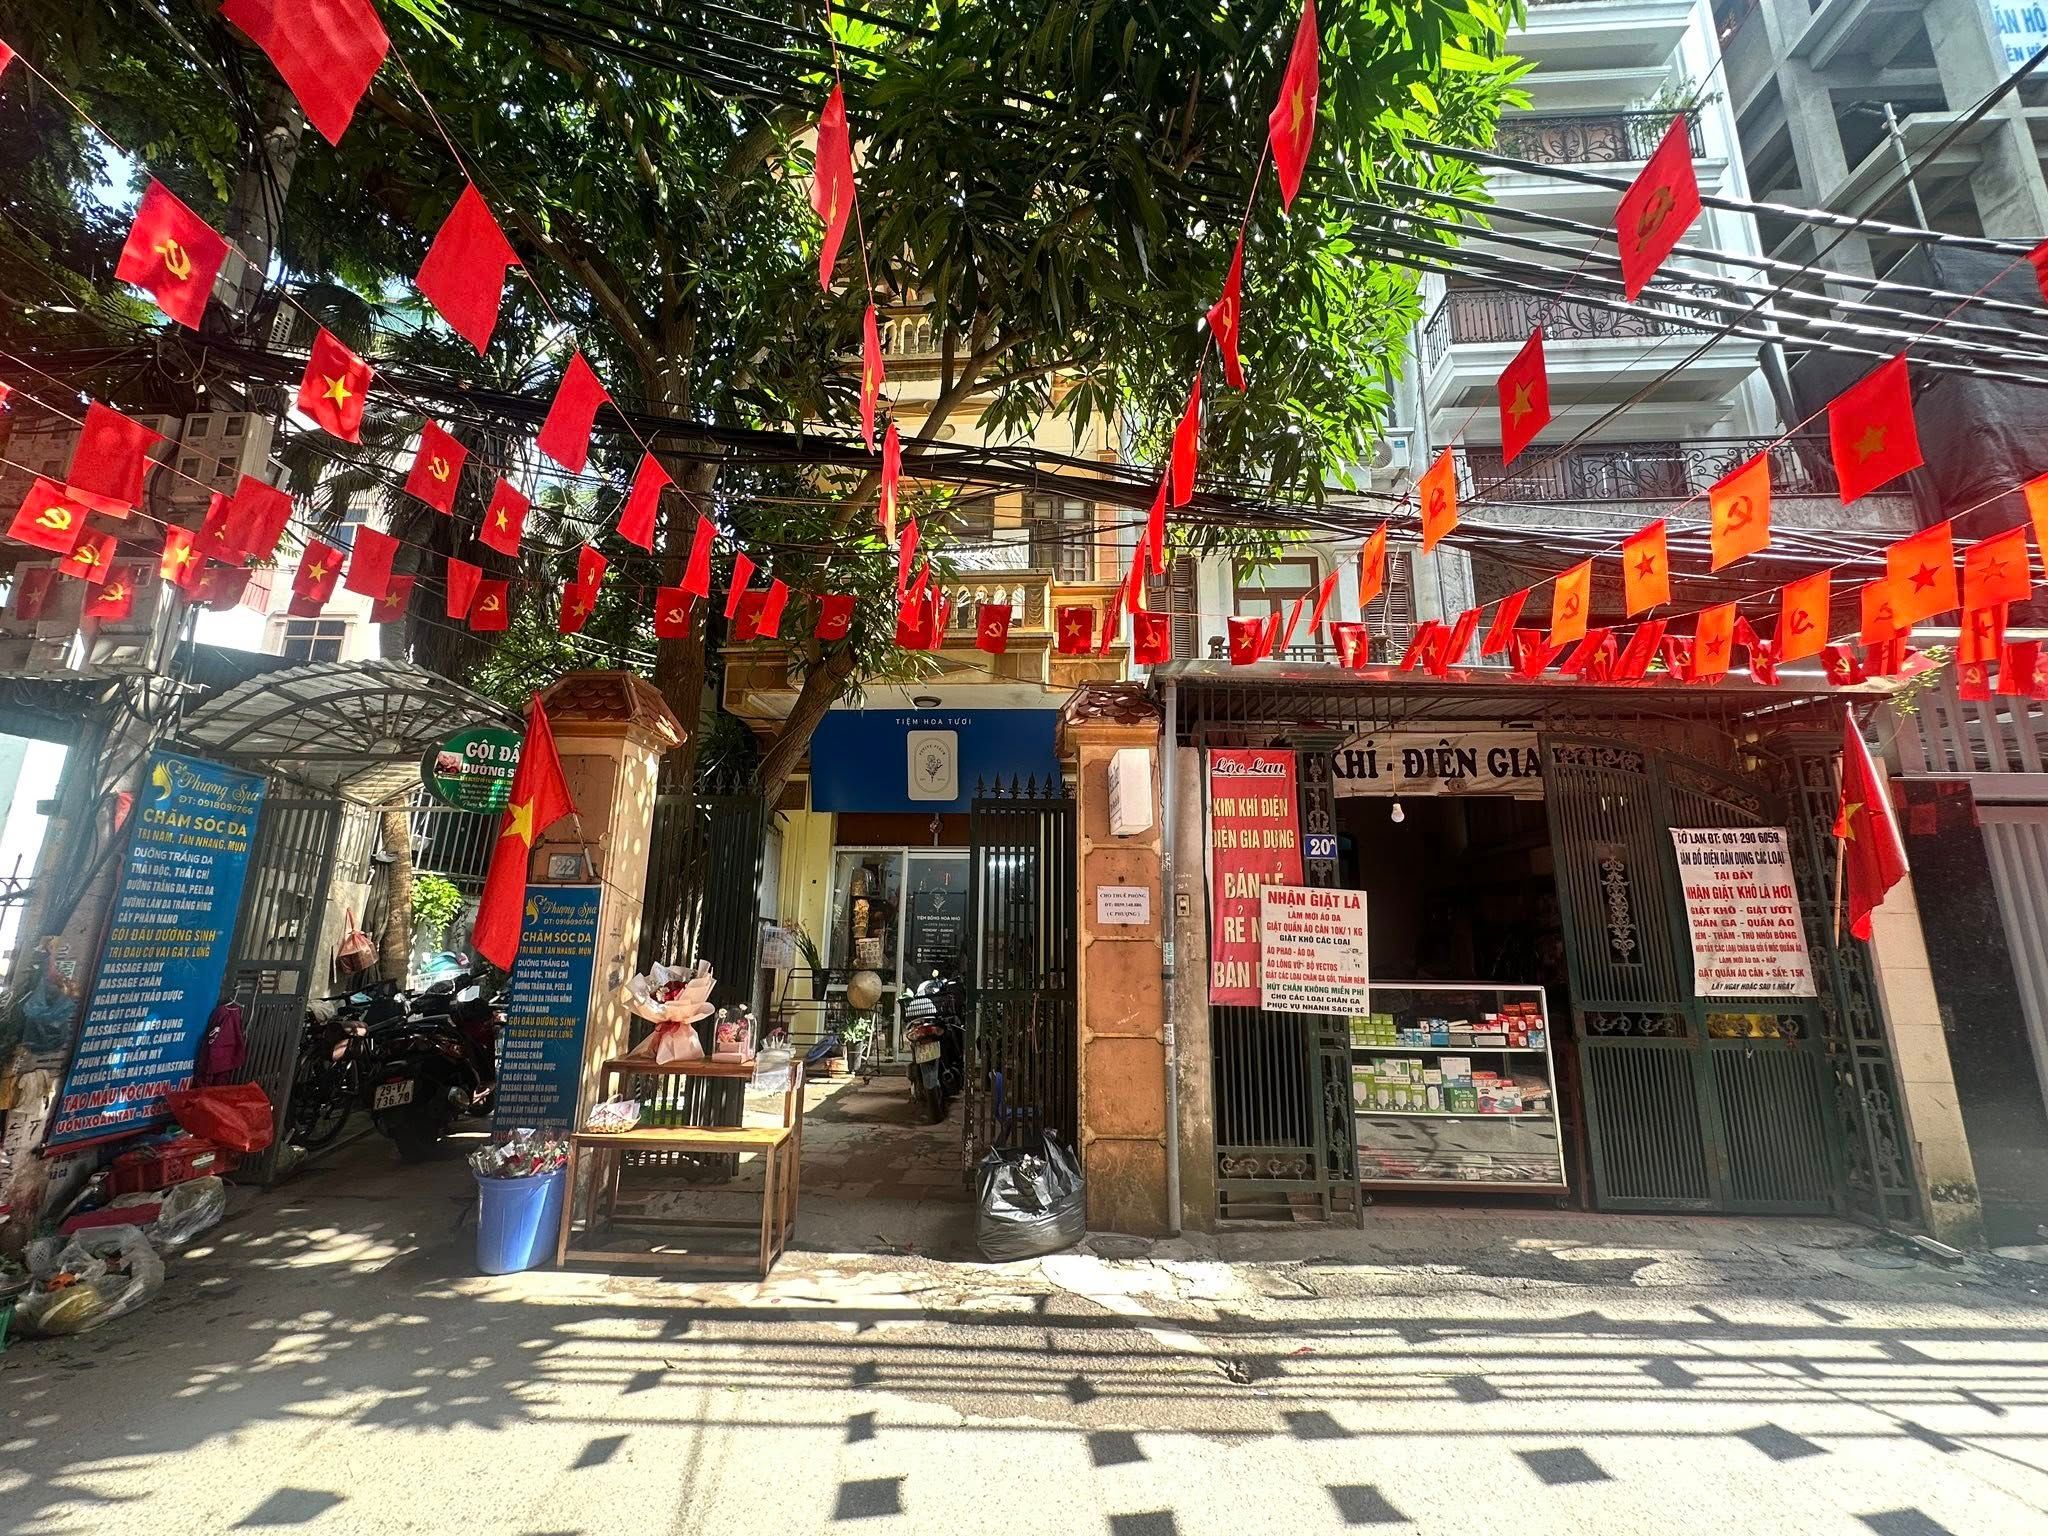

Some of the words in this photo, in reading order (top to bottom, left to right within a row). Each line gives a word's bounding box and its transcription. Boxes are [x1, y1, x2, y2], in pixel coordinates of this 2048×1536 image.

[896, 717, 918, 726] TIỆM
[948, 717, 972, 725] TƯƠI
[466, 739, 495, 763] GỘI
[500, 741, 522, 763] ĐẦ
[1212, 757, 1245, 778] Lộc
[1248, 757, 1286, 774] Lan
[1402, 738, 1478, 787] ĐIỆN
[1487, 748, 1543, 778] GIA
[177, 772, 229, 800] Phượng
[232, 784, 259, 803] Spa
[1213, 798, 1235, 817] KIM
[1239, 794, 1258, 816] KHÍ
[1261, 794, 1288, 821] ĐIỆN
[143, 809, 190, 829] CHĂM
[193, 815, 225, 833] SÓC
[227, 822, 247, 837] DA
[1240, 829, 1260, 849] GIA
[1264, 829, 1294, 852] DỤNG
[1690, 833, 1706, 843] LAN
[1708, 833, 1721, 844] ĐT:
[1722, 833, 1738, 843] 091
[1741, 832, 1756, 843] 290
[1758, 832, 1780, 843] 6059
[1311, 838, 1335, 856] 20A
[134, 847, 167, 860] DƯỠNG
[168, 849, 200, 864] TRẮNG
[200, 855, 213, 865] DA
[1704, 849, 1719, 868] ĐIỆN
[1735, 851, 1755, 868] DỤNG
[1768, 851, 1785, 867] LOẠI
[556, 859, 576, 875] 22
[1714, 872, 1729, 881] TẠI
[1733, 870, 1753, 880] ĐÂY
[1224, 867, 1259, 899] BÁN
[1686, 884, 1710, 902] NHẬN
[1712, 884, 1734, 902] GIẶT
[1736, 883, 1757, 899] KHÔ
[1759, 883, 1770, 899] LÀ
[1772, 885, 1792, 899] HƠI
[161, 900, 172, 909] DA
[1268, 890, 1305, 907] NHẬN
[1310, 891, 1339, 910] GIẶT
[1344, 893, 1360, 909] LÀ
[578, 902, 598, 918] Spa
[1288, 911, 1302, 919] LÀM
[1321, 913, 1329, 921] ÁO
[1332, 914, 1341, 922] DA
[1690, 906, 1710, 916] GIẶT
[1713, 905, 1736, 914] KHÔ
[1746, 906, 1767, 915] GIẶT
[156, 914, 179, 924] NANO
[1224, 905, 1246, 943] RẺ
[1721, 919, 1737, 927] GA
[1778, 917, 1794, 926] ÁO
[154, 926, 192, 941] DƯỠNG
[194, 930, 216, 941] SINH
[1267, 920, 1282, 933] GIẶT
[1304, 924, 1313, 933] ÁO
[1348, 927, 1351, 936] 1
[1354, 928, 1363, 936] KG
[522, 930, 552, 942] CHĂM
[555, 930, 576, 943] SÓC
[578, 933, 592, 943] DA
[1280, 934, 1296, 944] GIẶT
[1298, 935, 1314, 943] KHÔ
[1316, 936, 1331, 944] CÁC
[155, 947, 169, 957] VAI
[1267, 946, 1275, 954] ÁO
[1276, 947, 1292, 955] PHAO
[103, 963, 141, 974] MASSAGE
[142, 962, 164, 972] BODY
[1267, 958, 1275, 968] ÁO
[1214, 956, 1250, 988] BÁN
[1278, 972, 1289, 980] CÁC
[1790, 969, 1805, 977] 15K
[98, 977, 139, 989] MASSAGE
[139, 975, 162, 987] CHÂN
[1267, 982, 1280, 991] HÚT
[1282, 982, 1302, 992] CHÂN
[1304, 984, 1329, 993] KHÔNG
[1352, 987, 1364, 996] PHÍ
[1289, 993, 1304, 1001] CÁC
[1267, 1002, 1287, 1010] PHỤC
[560, 1017, 576, 1027] SINH
[85, 1023, 122, 1037] MASSAGE
[62, 1094, 89, 1117] TẠO
[118, 1081, 144, 1103] TÓC
[144, 1079, 170, 1098] NAM
[116, 1107, 137, 1123] TAY
